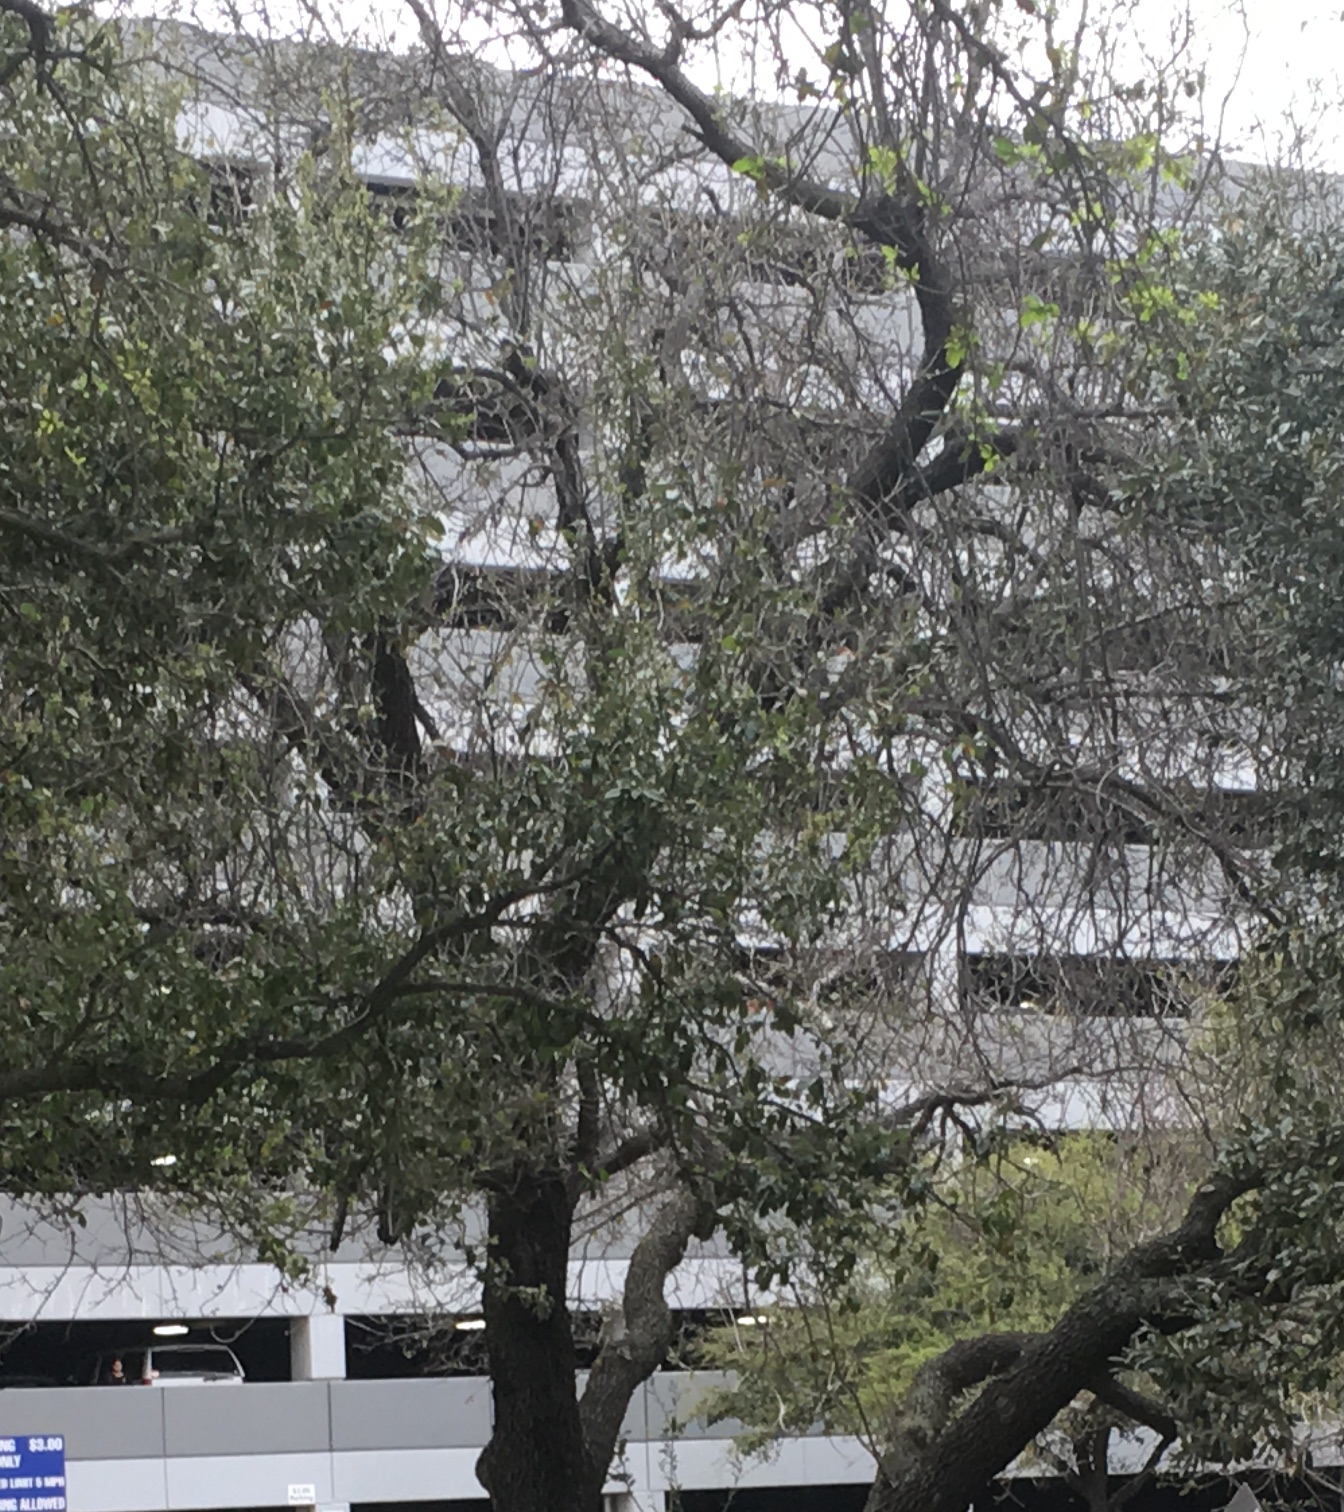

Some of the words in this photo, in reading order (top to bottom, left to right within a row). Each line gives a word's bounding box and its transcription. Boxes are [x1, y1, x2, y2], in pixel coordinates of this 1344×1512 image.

[10, 1477, 33, 1489] LIMIT
[44, 1476, 65, 1487] MPH
[20, 1497, 65, 1512] ALLOWED
